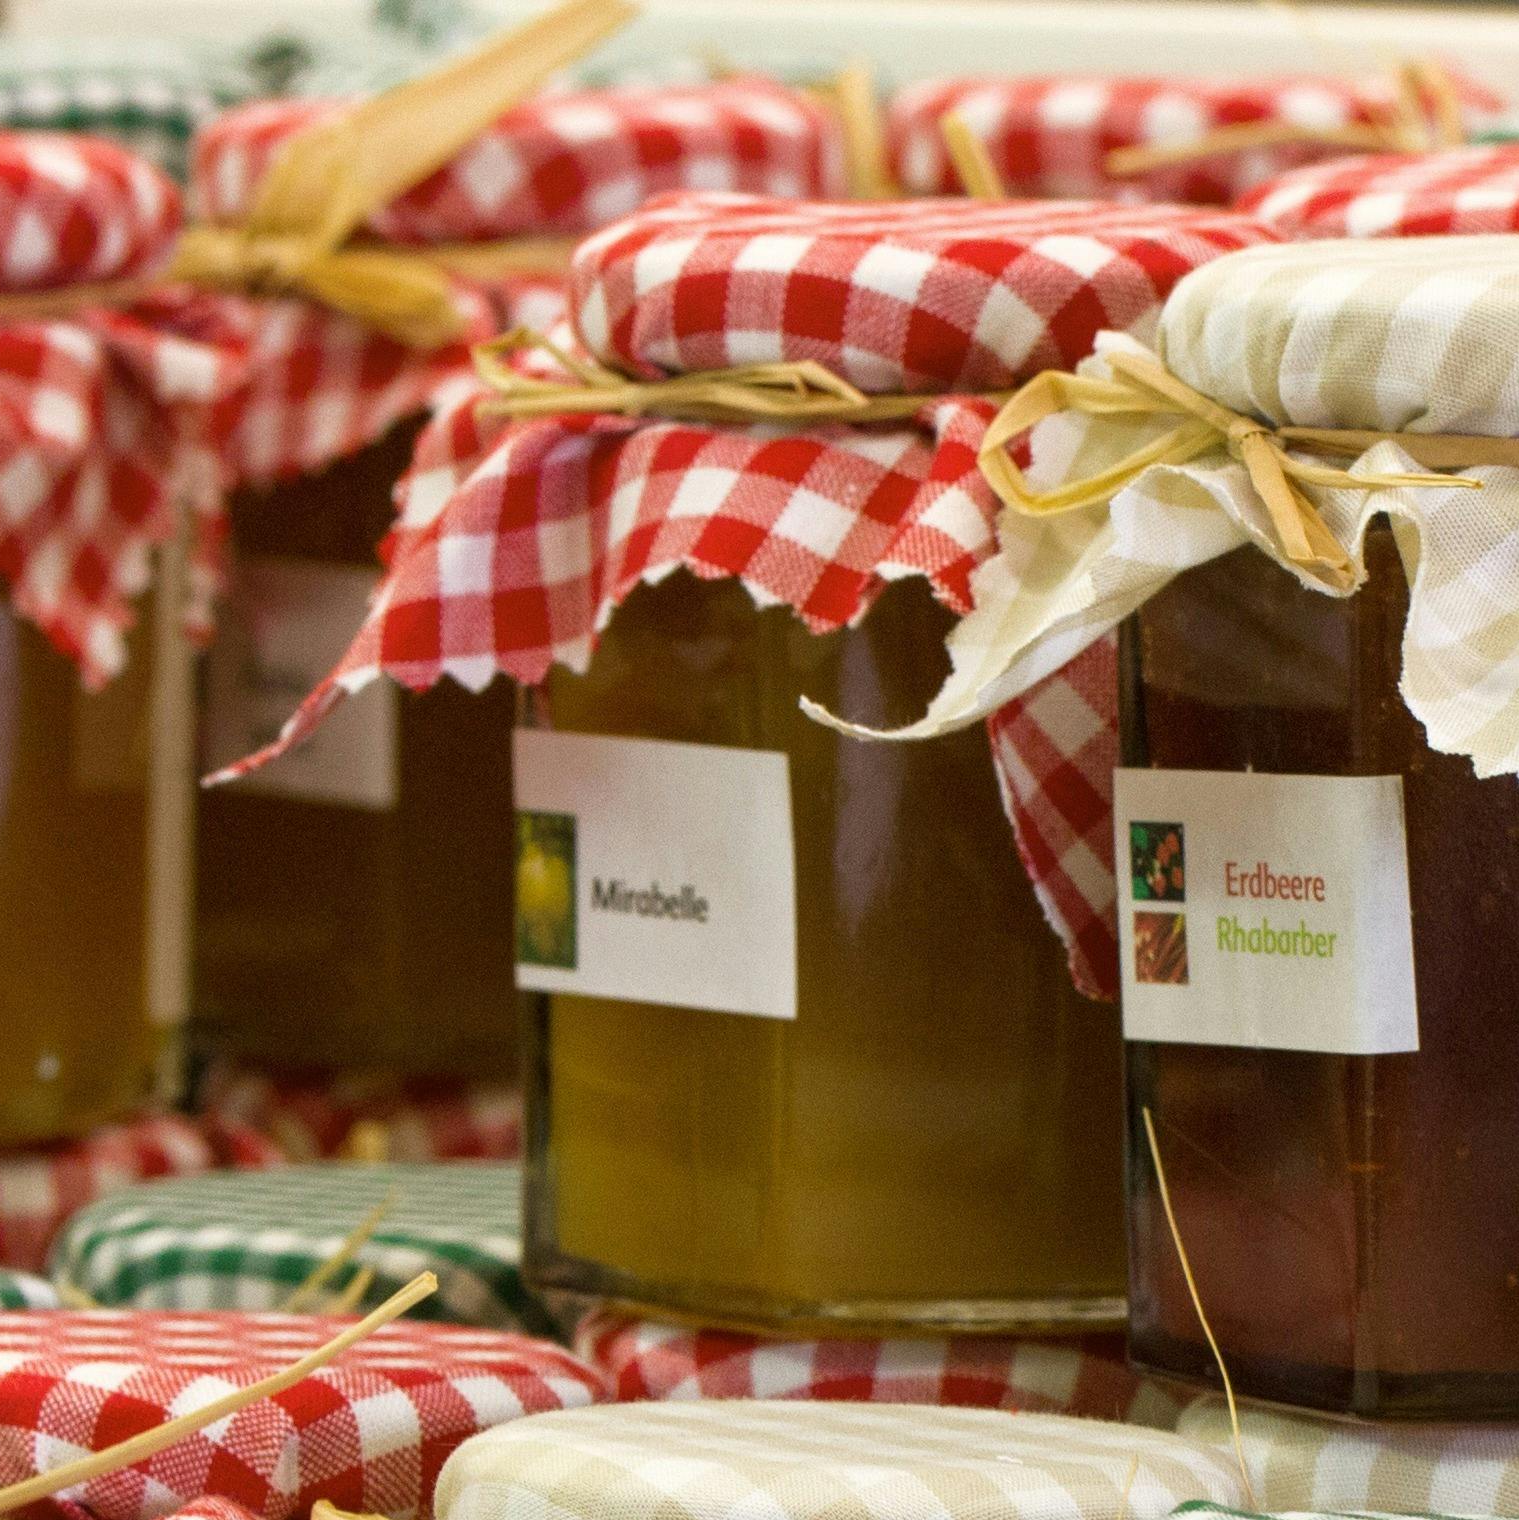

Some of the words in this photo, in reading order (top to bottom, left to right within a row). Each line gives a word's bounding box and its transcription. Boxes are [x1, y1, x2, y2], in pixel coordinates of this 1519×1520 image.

[591, 876, 708, 923] Mirabelle
[1224, 861, 1327, 902] Erdbeere
[1216, 915, 1337, 958] Rhabarber
